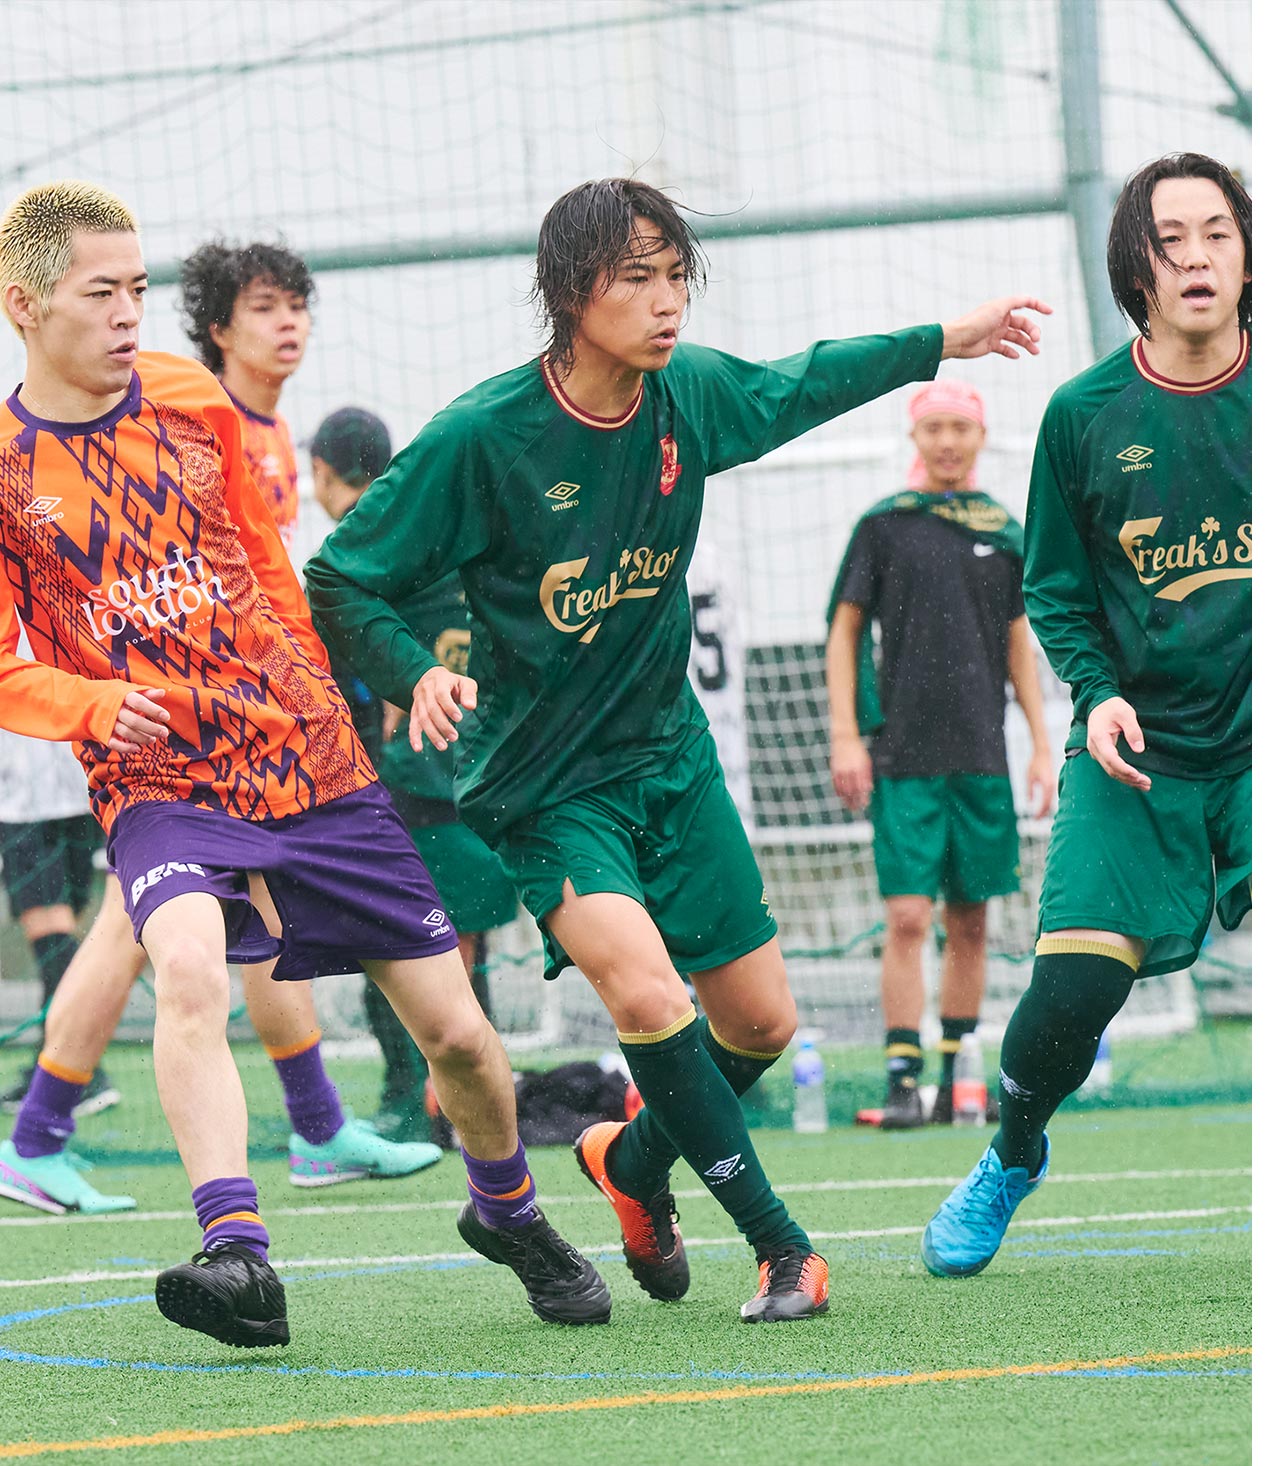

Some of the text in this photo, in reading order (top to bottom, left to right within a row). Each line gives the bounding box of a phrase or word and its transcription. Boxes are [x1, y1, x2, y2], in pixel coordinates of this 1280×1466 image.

[1121, 462, 1153, 473] umbro
[551, 499, 580, 512] umbro
[32, 511, 65, 527] umbro
[87, 546, 205, 612] south
[80, 575, 230, 641] london
[430, 924, 450, 938] umbr
